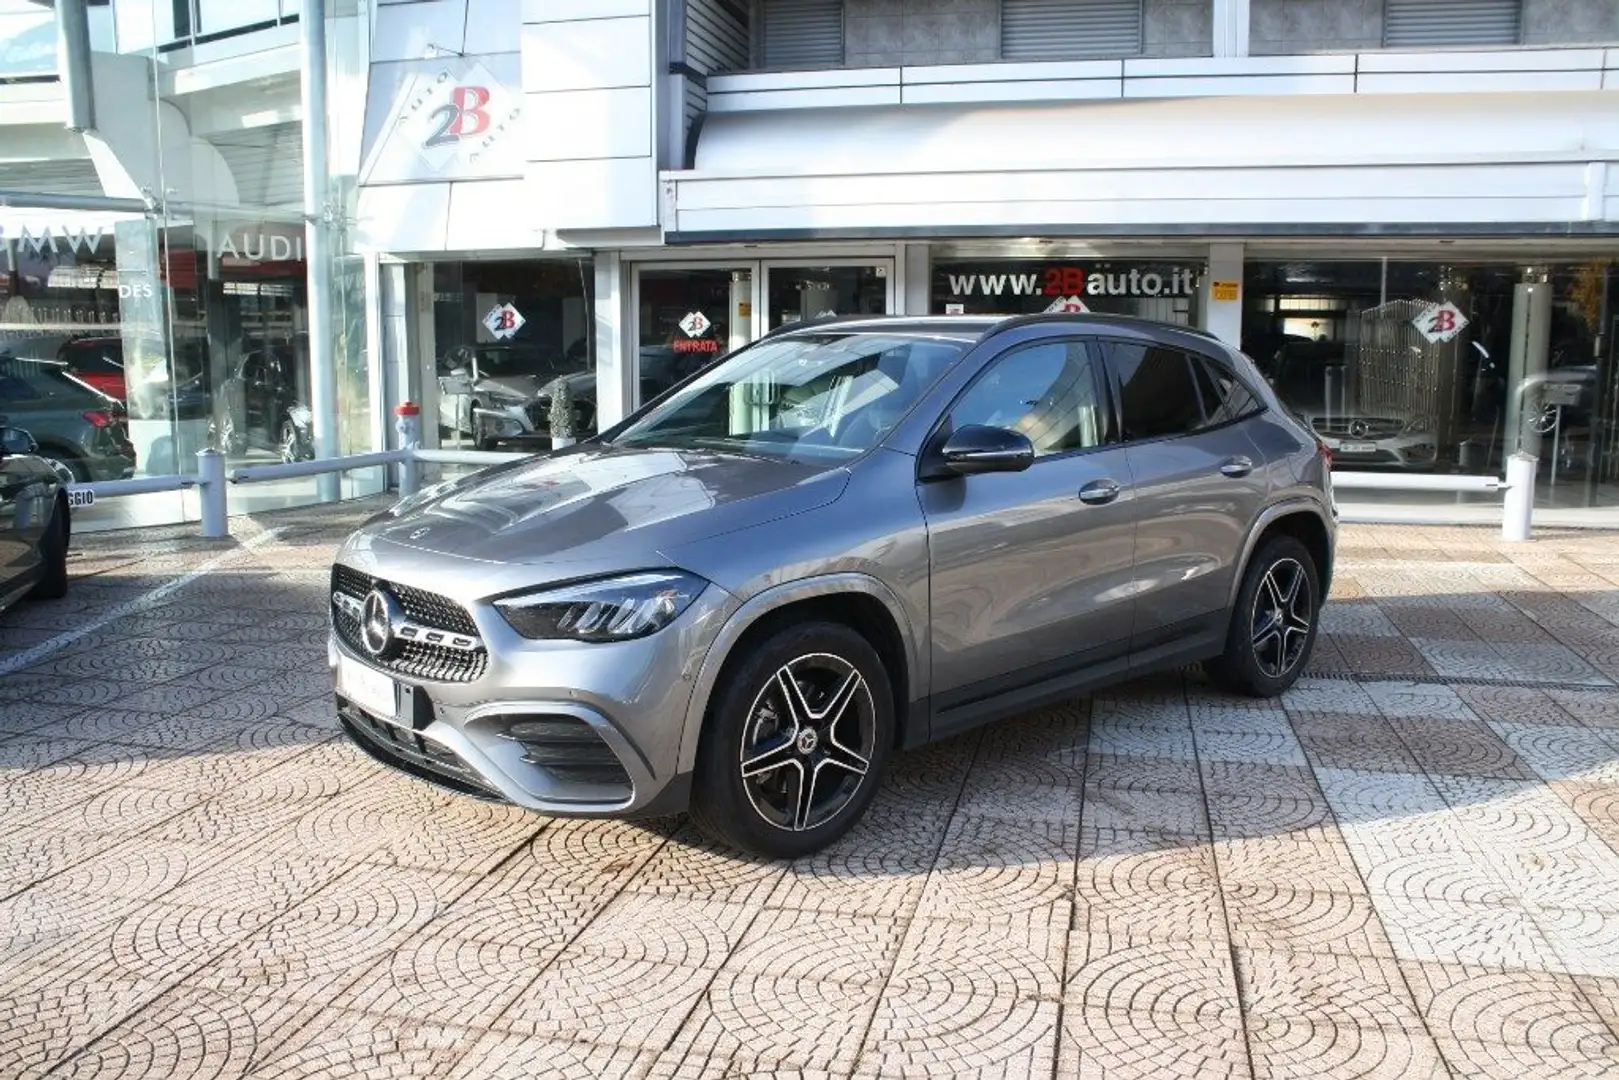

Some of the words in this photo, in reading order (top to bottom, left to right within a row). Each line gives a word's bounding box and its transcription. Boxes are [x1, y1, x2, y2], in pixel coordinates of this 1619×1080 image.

[424, 86, 491, 148] 2B
[216, 232, 302, 262] AUDI
[118, 284, 153, 299] DES
[949, 267, 1194, 297] www.2Bauto.it
[494, 309, 516, 331] 2B
[687, 316, 704, 332] 2B
[1427, 310, 1455, 333] 2B
[673, 339, 719, 352] ENTRATA
